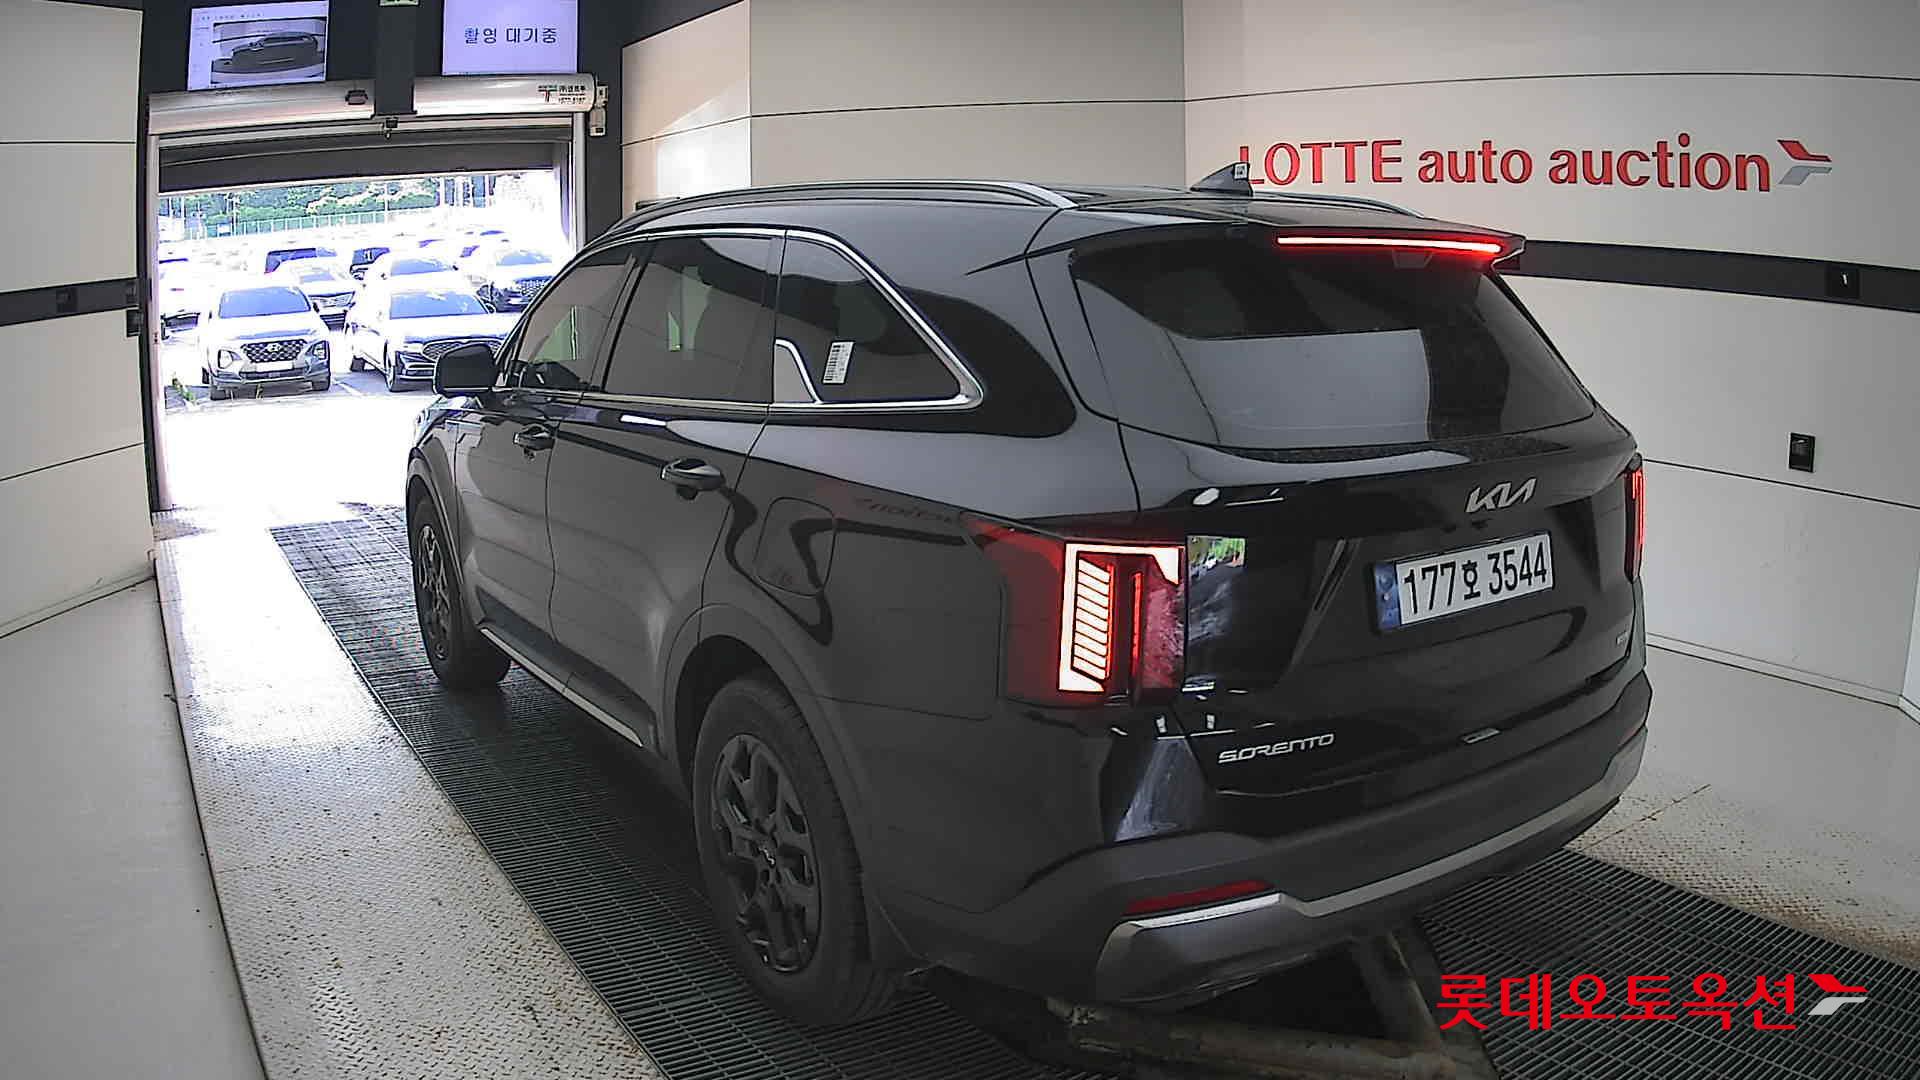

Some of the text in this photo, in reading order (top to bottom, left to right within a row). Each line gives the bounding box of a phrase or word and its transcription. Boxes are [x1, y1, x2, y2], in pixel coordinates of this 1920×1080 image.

[506, 27, 557, 44] 대기중
[1418, 140, 1533, 184] auto
[1548, 133, 1771, 192] auction
[1465, 477, 1537, 513] KIA
[1403, 541, 1548, 615] 177호 3544
[1218, 733, 1335, 764] SORENTO
